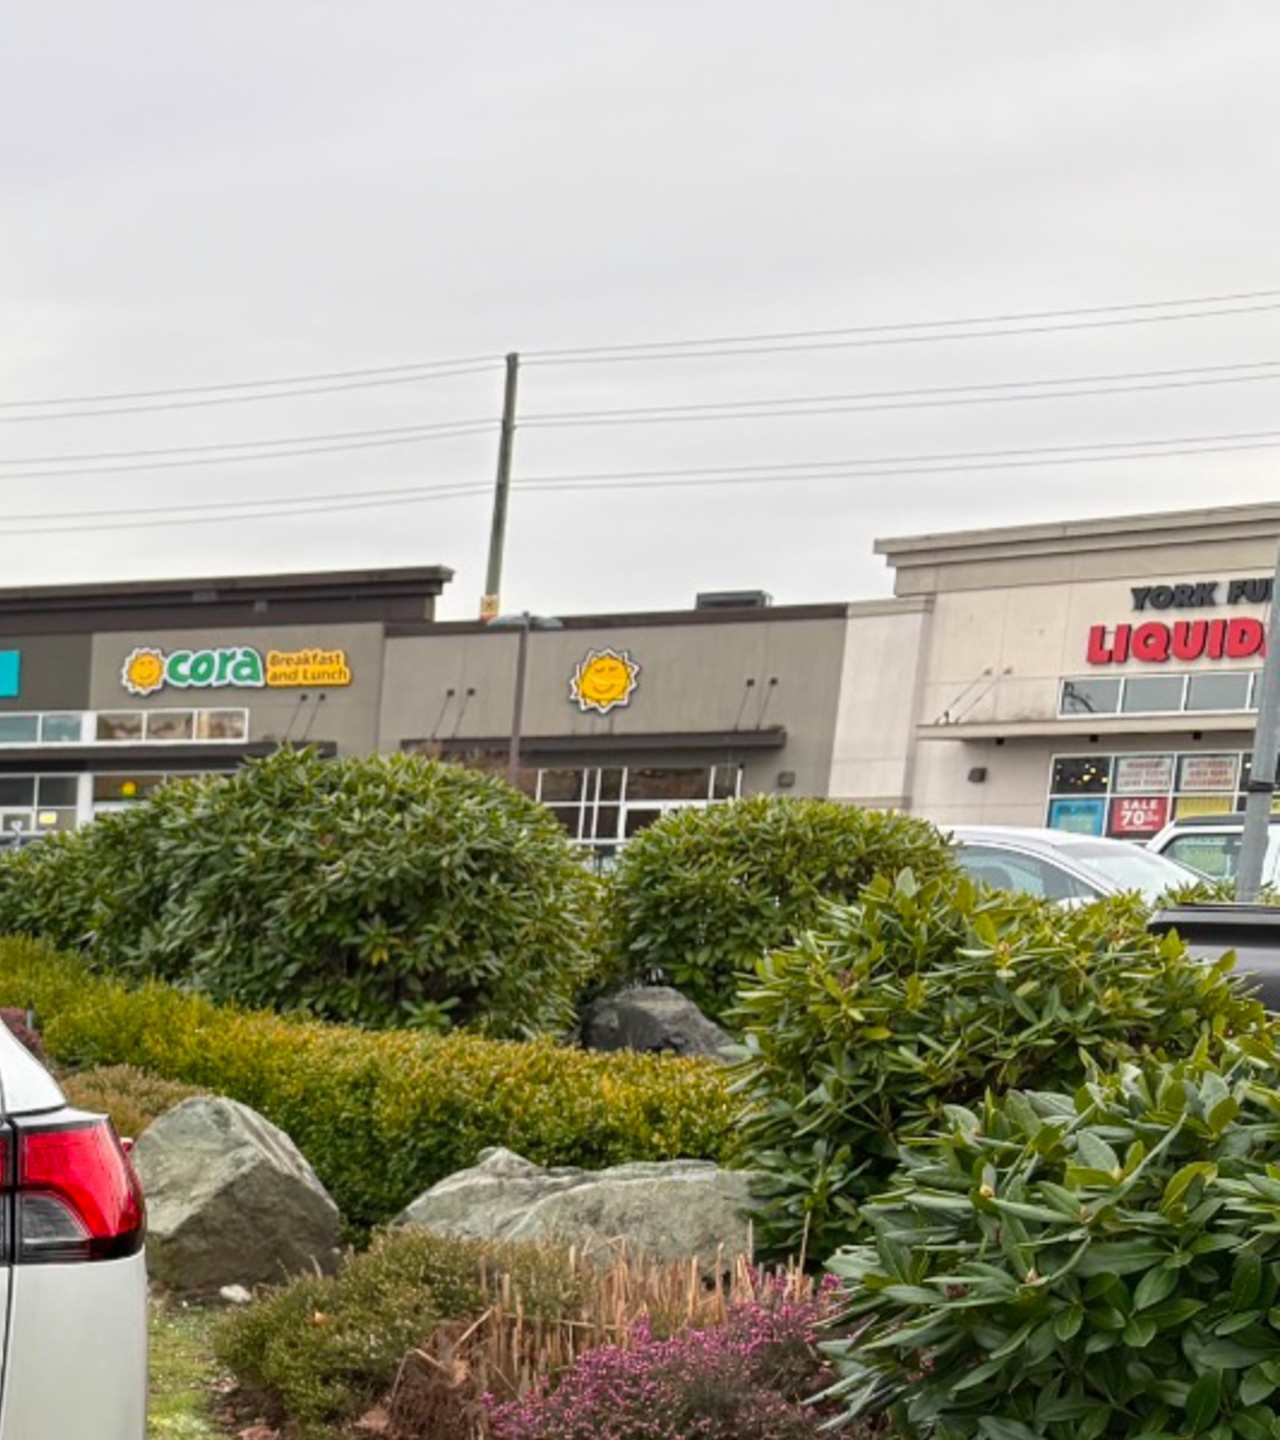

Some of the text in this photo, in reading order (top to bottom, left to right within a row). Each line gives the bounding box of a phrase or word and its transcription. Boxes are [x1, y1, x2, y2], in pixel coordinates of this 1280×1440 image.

[1131, 582, 1218, 611] YORK
[1087, 617, 1267, 664] LIQUID
[166, 647, 264, 687] cora
[269, 652, 341, 667] Breakfast
[269, 667, 348, 682] and Lunch
[1121, 799, 1159, 810] SALE
[1120, 810, 1145, 826] 70
